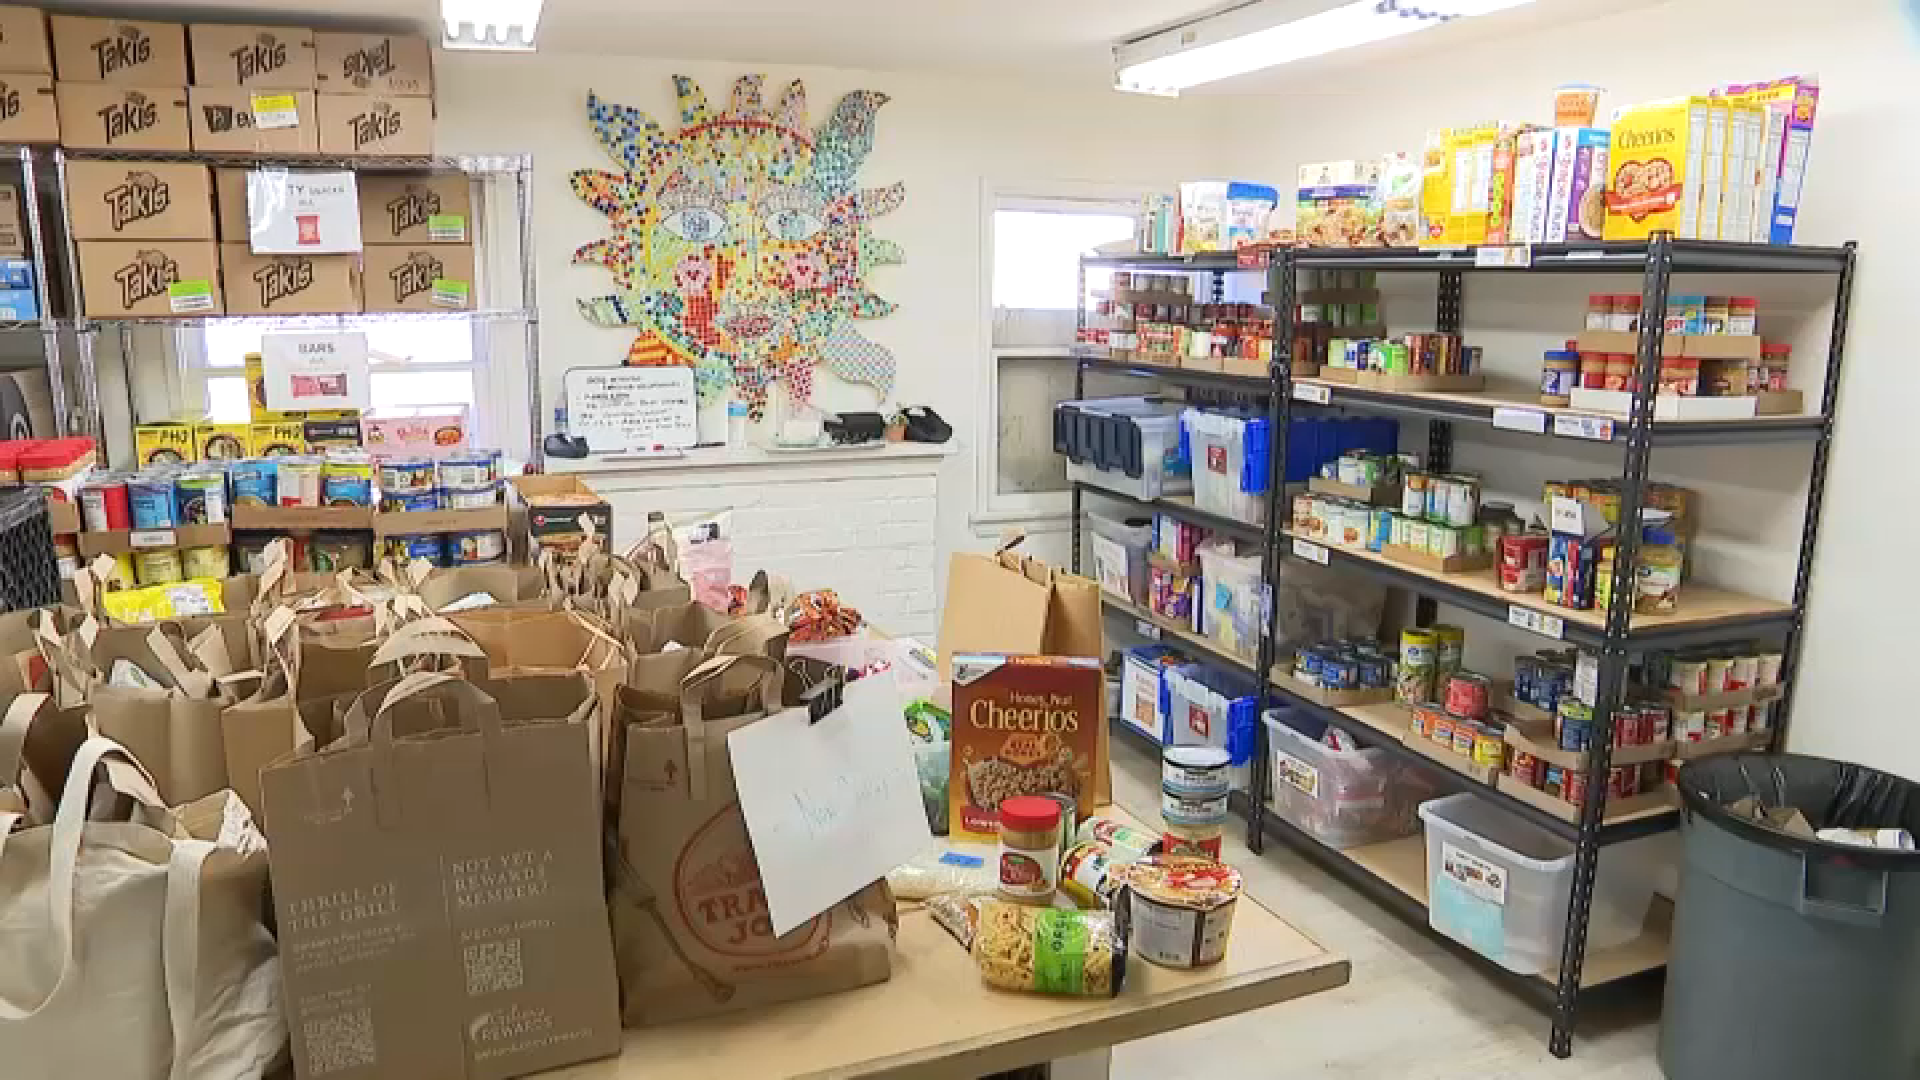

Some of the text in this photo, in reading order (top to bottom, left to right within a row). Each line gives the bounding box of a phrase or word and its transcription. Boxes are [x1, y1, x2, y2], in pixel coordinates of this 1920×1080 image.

[90, 37, 151, 80] Takis
[229, 44, 287, 86] Takis
[97, 102, 158, 145] Takis
[347, 111, 402, 151] Takis
[1618, 127, 1676, 150] Cheerios
[104, 182, 171, 233] Takis
[253, 259, 313, 308] Takis
[970, 699, 1079, 731] Cheerios
[452, 849, 553, 875] NOT YET A
[455, 865, 546, 893] REWARDS
[288, 882, 396, 915] THRILL OF
[288, 901, 400, 933] THE GRILL
